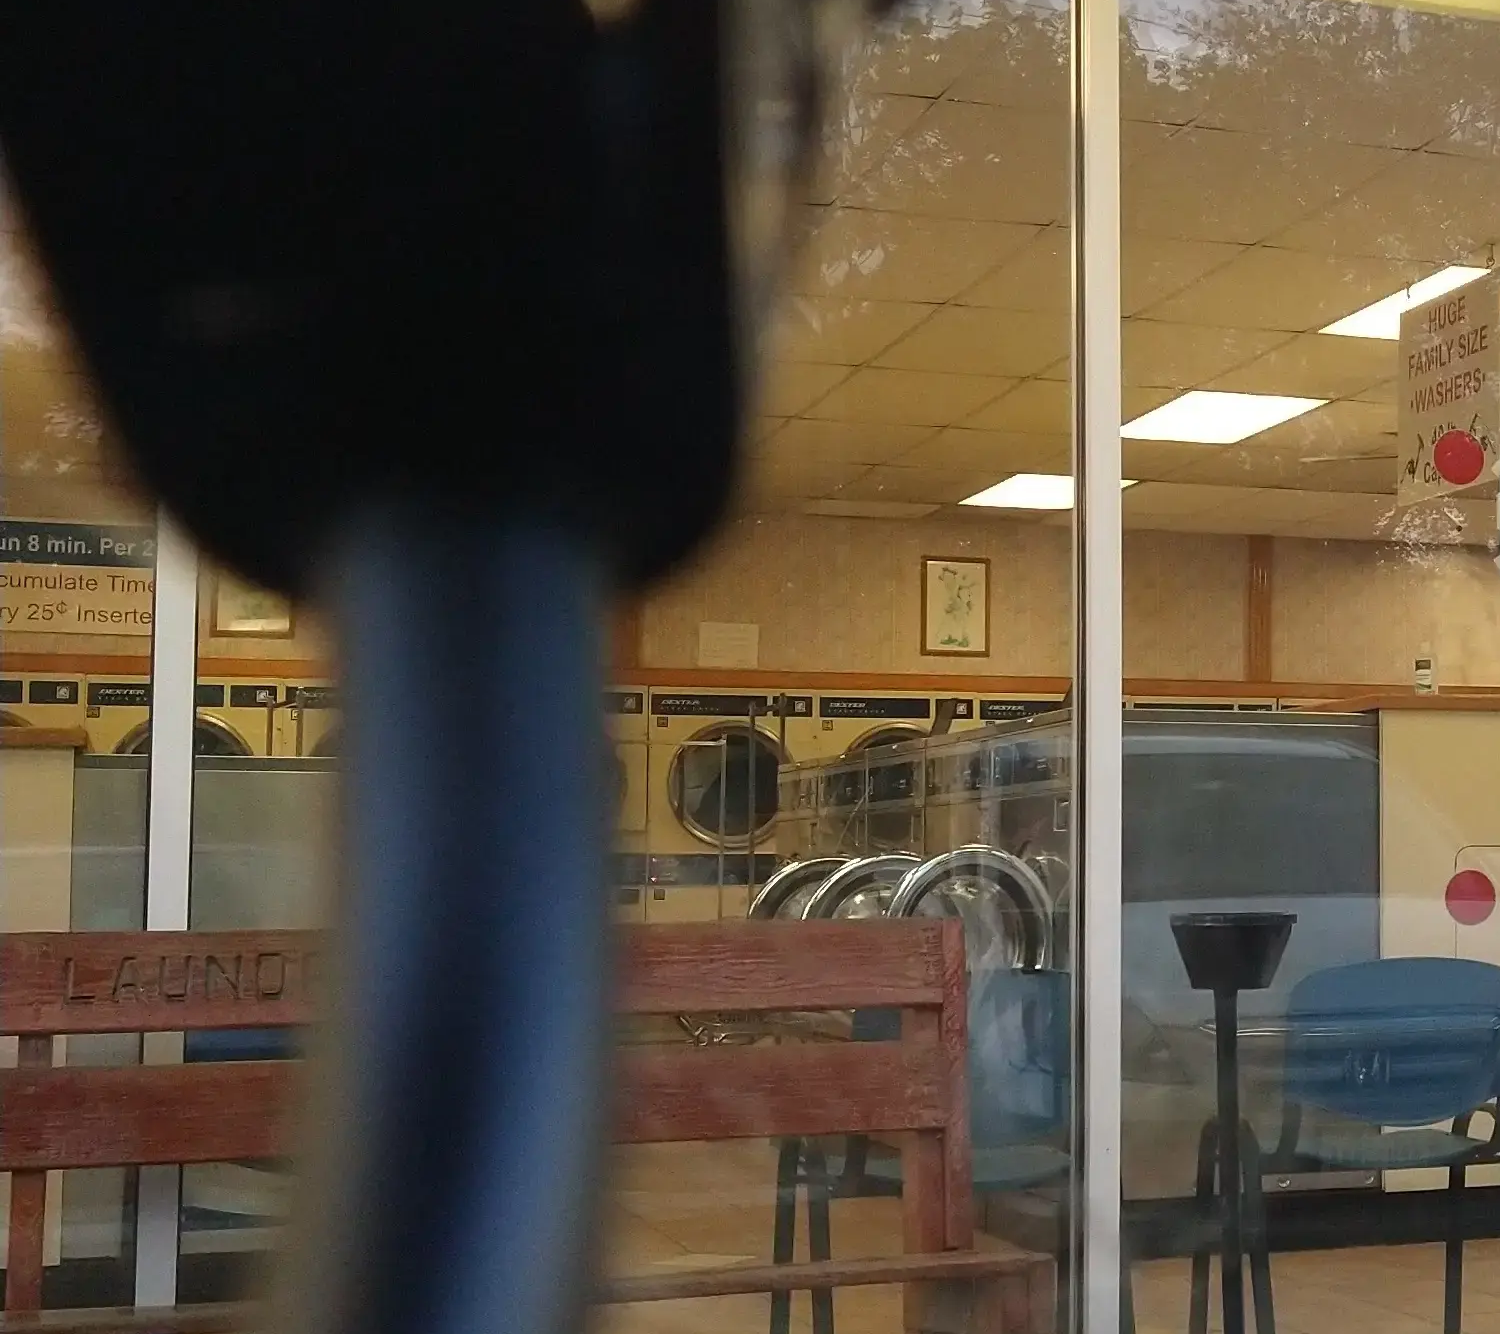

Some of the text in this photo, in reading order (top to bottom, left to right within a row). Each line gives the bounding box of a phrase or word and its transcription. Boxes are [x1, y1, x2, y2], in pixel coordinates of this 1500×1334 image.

[1428, 296, 1465, 334] HUGE
[1408, 325, 1489, 381] FAMILY SIZE
[28, 535, 40, 552] 8
[47, 537, 92, 554] min.
[99, 537, 137, 556] Per
